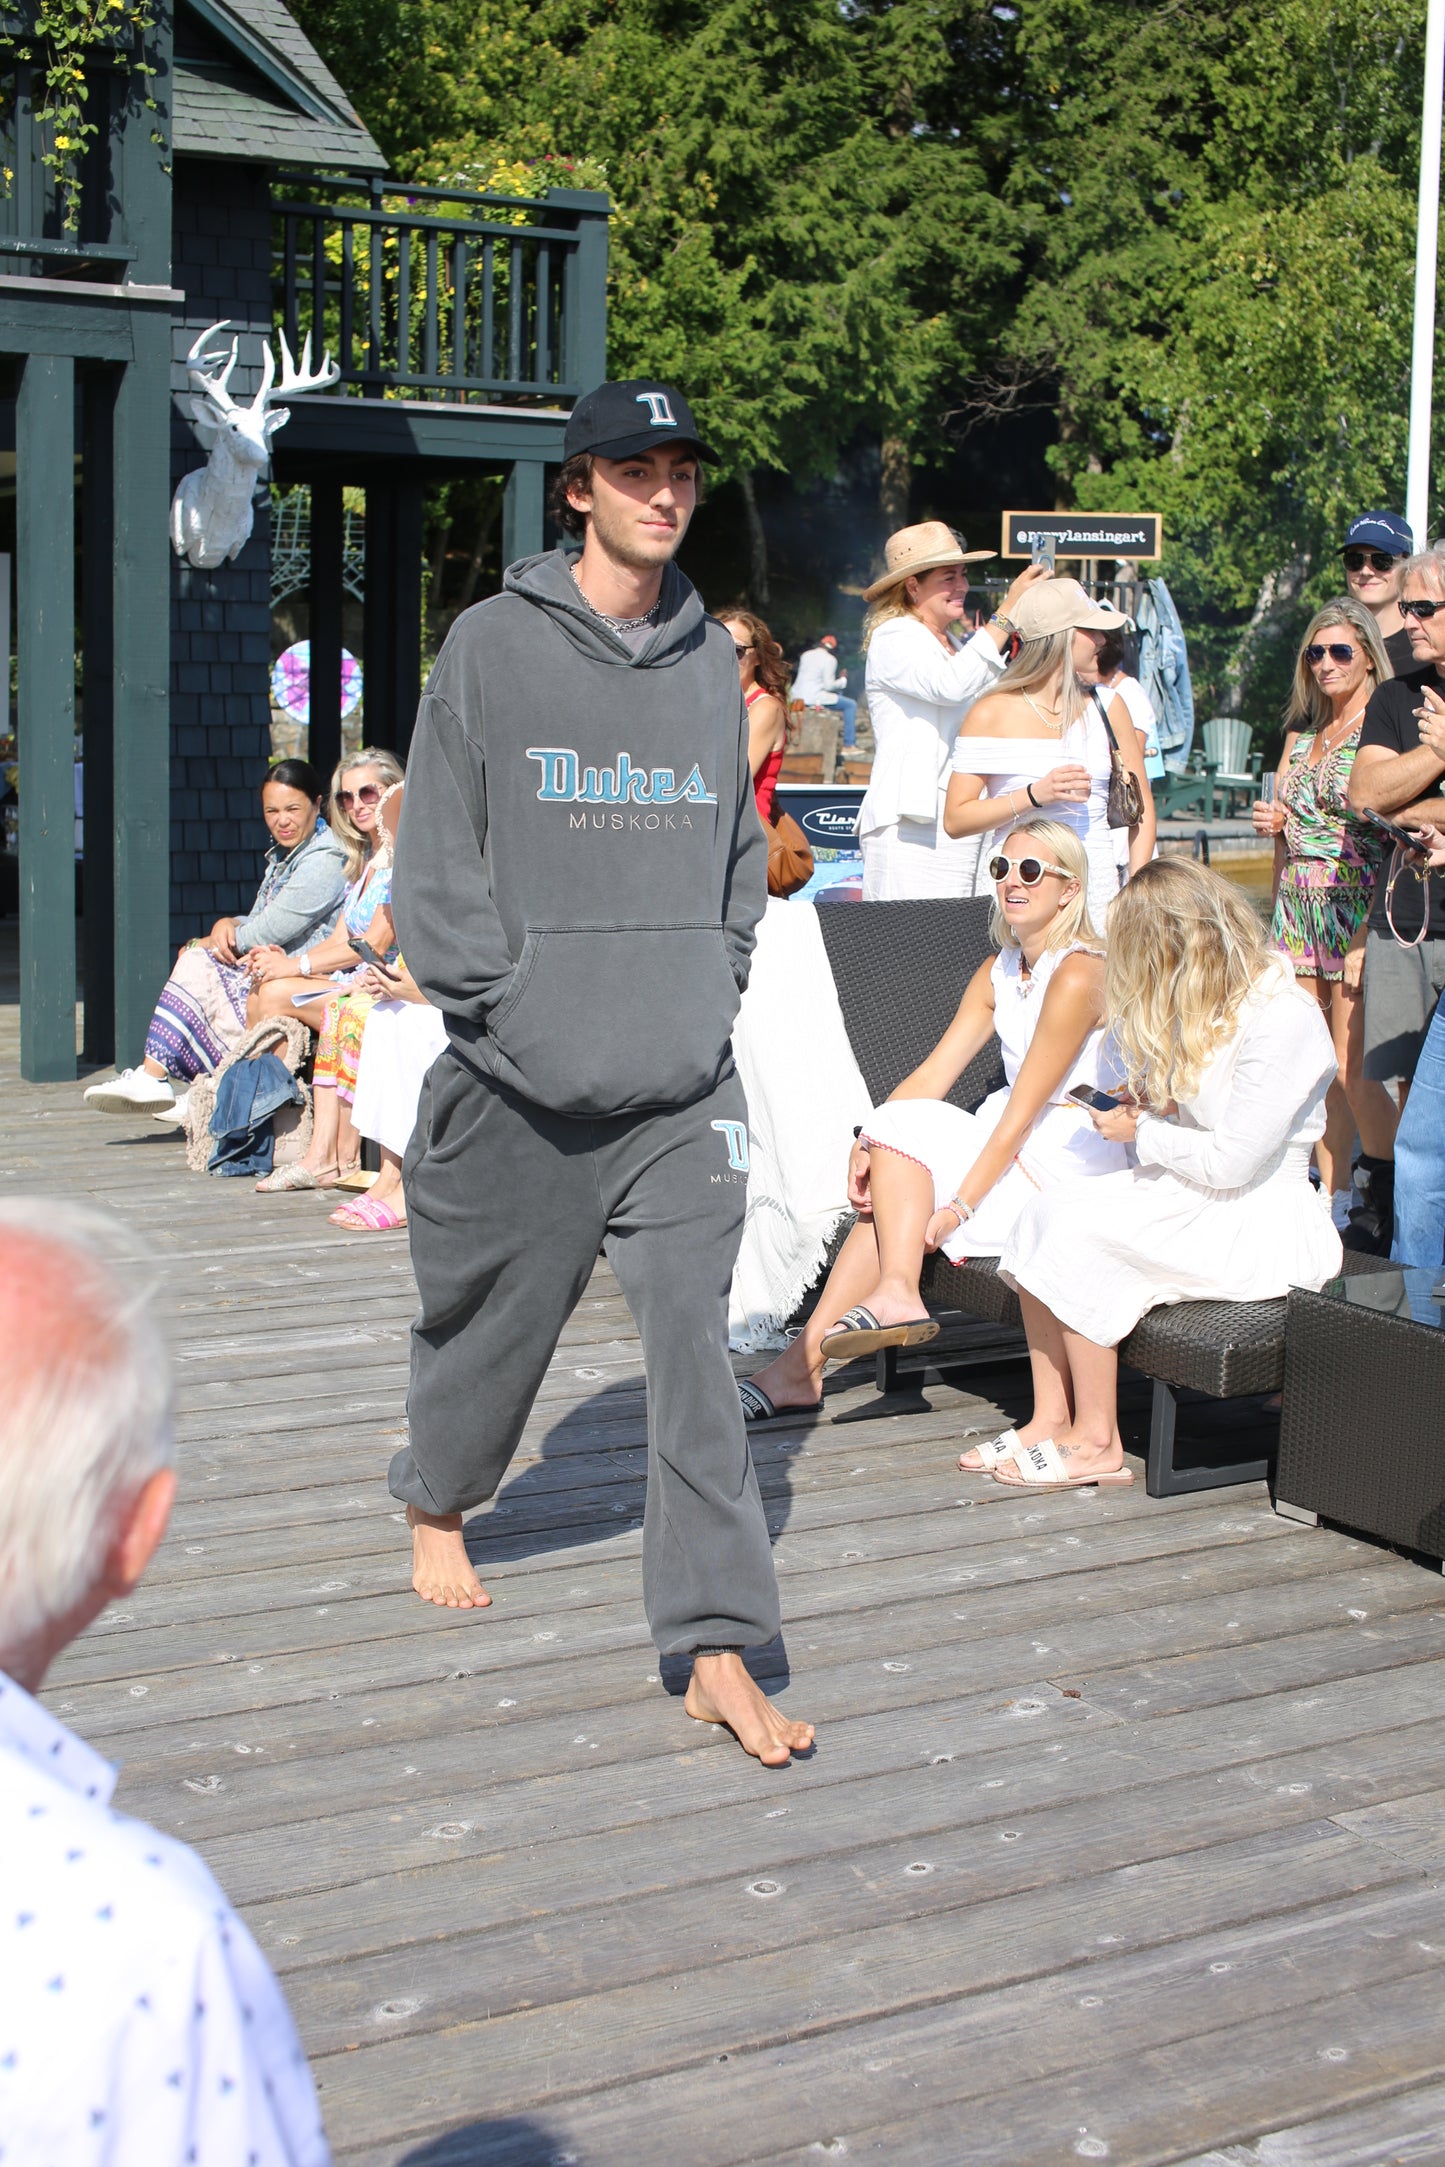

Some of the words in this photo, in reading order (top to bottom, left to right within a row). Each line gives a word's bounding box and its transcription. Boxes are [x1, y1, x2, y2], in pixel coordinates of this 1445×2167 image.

[1016, 529, 1146, 545] @pylansingart
[525, 747, 718, 805] Dukes
[569, 812, 694, 831] MUSKOKA
[744, 1396, 762, 1413] DIOR
